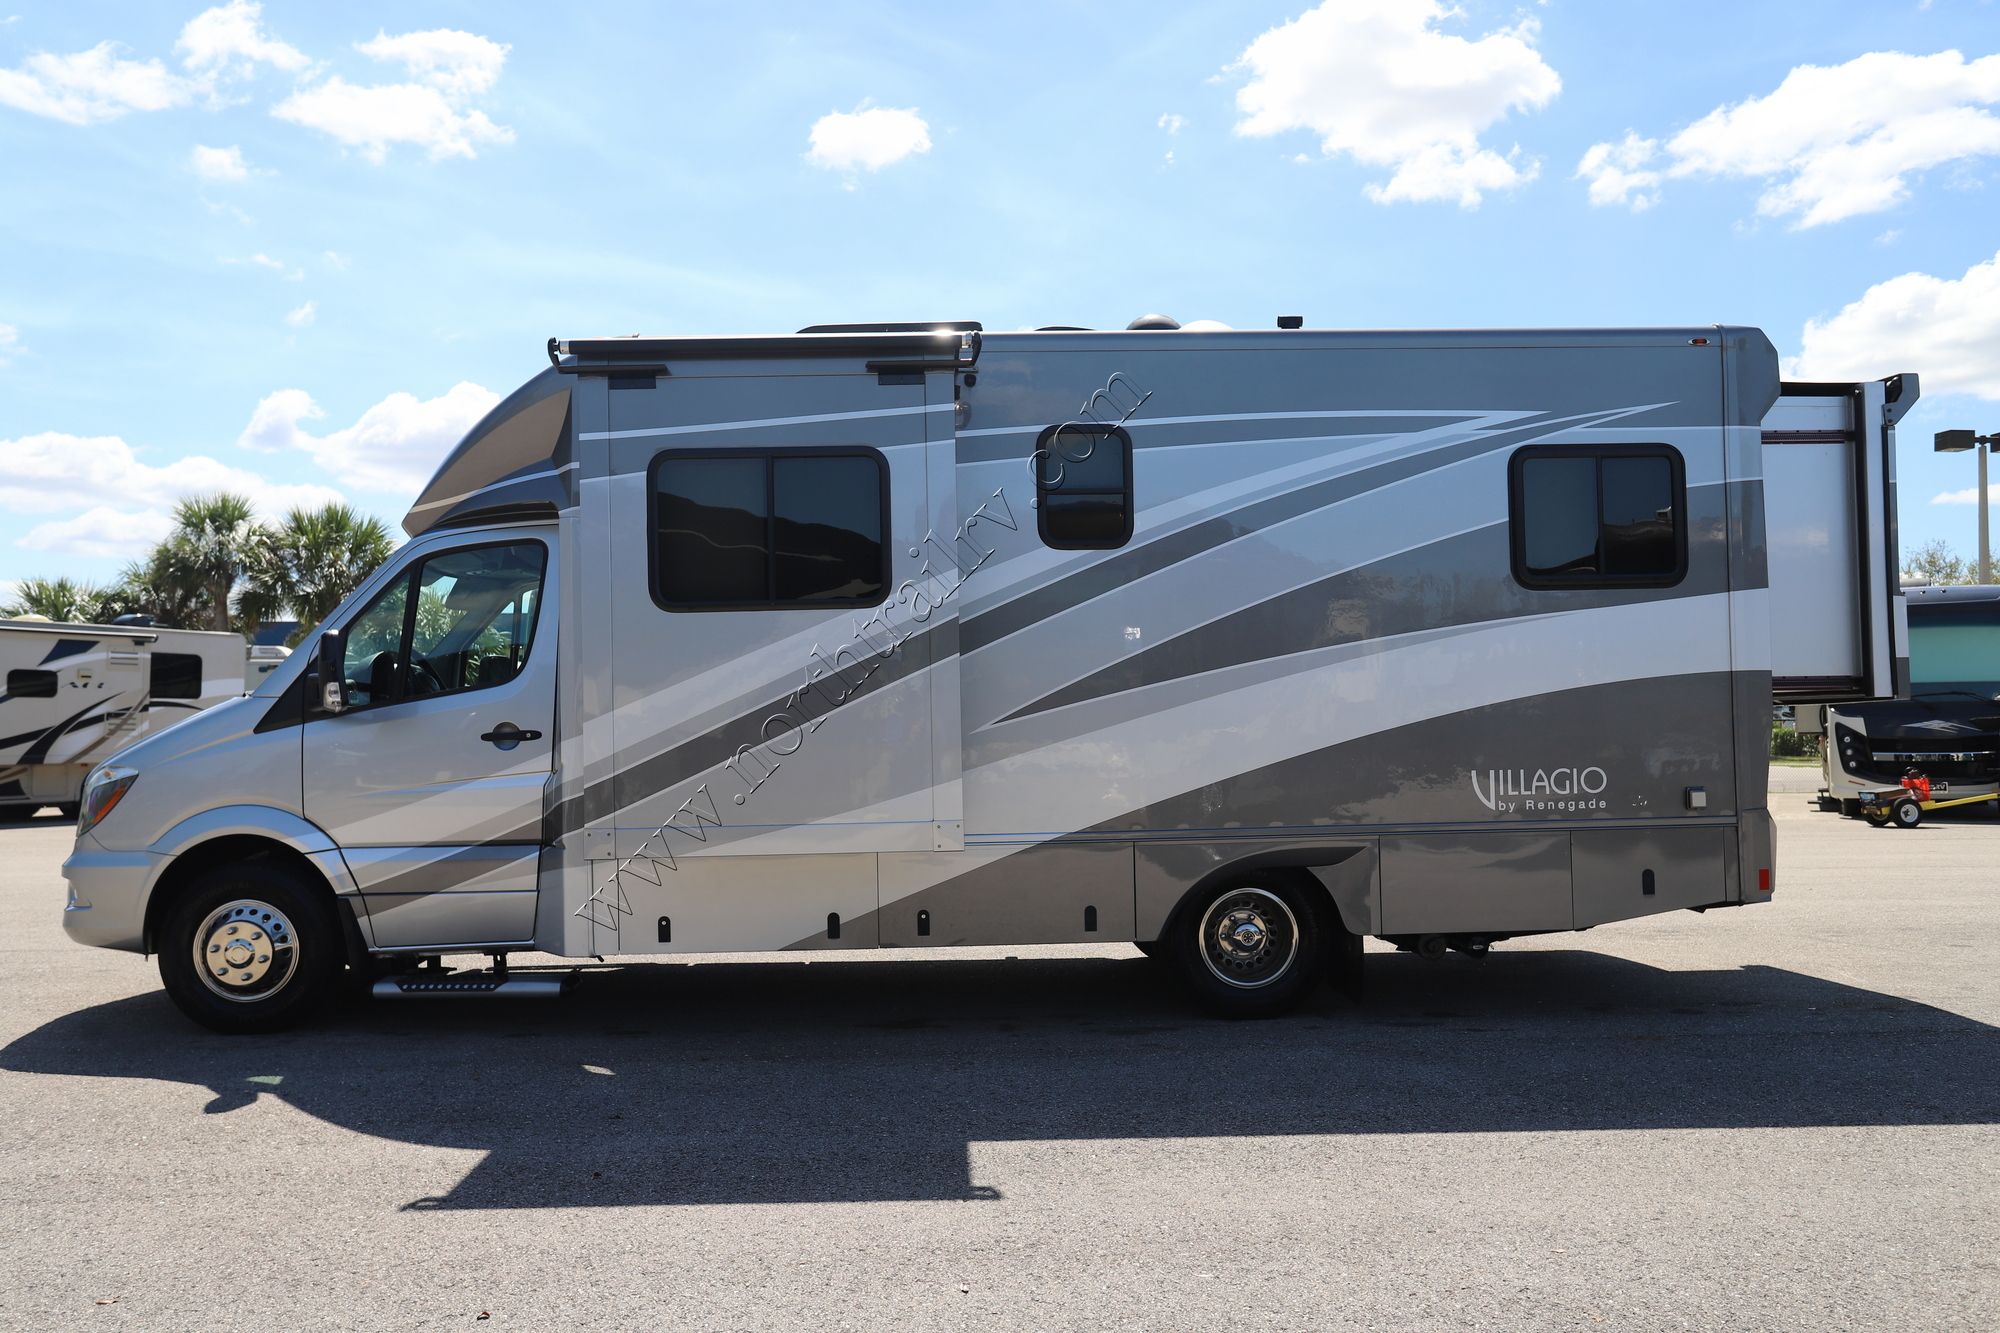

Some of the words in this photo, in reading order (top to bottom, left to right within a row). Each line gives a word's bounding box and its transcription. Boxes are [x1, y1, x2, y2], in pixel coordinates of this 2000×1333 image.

[1471, 766, 1607, 811] VILLAGIO
[1498, 800, 1516, 812] by
[1526, 798, 1607, 812] Renegade
